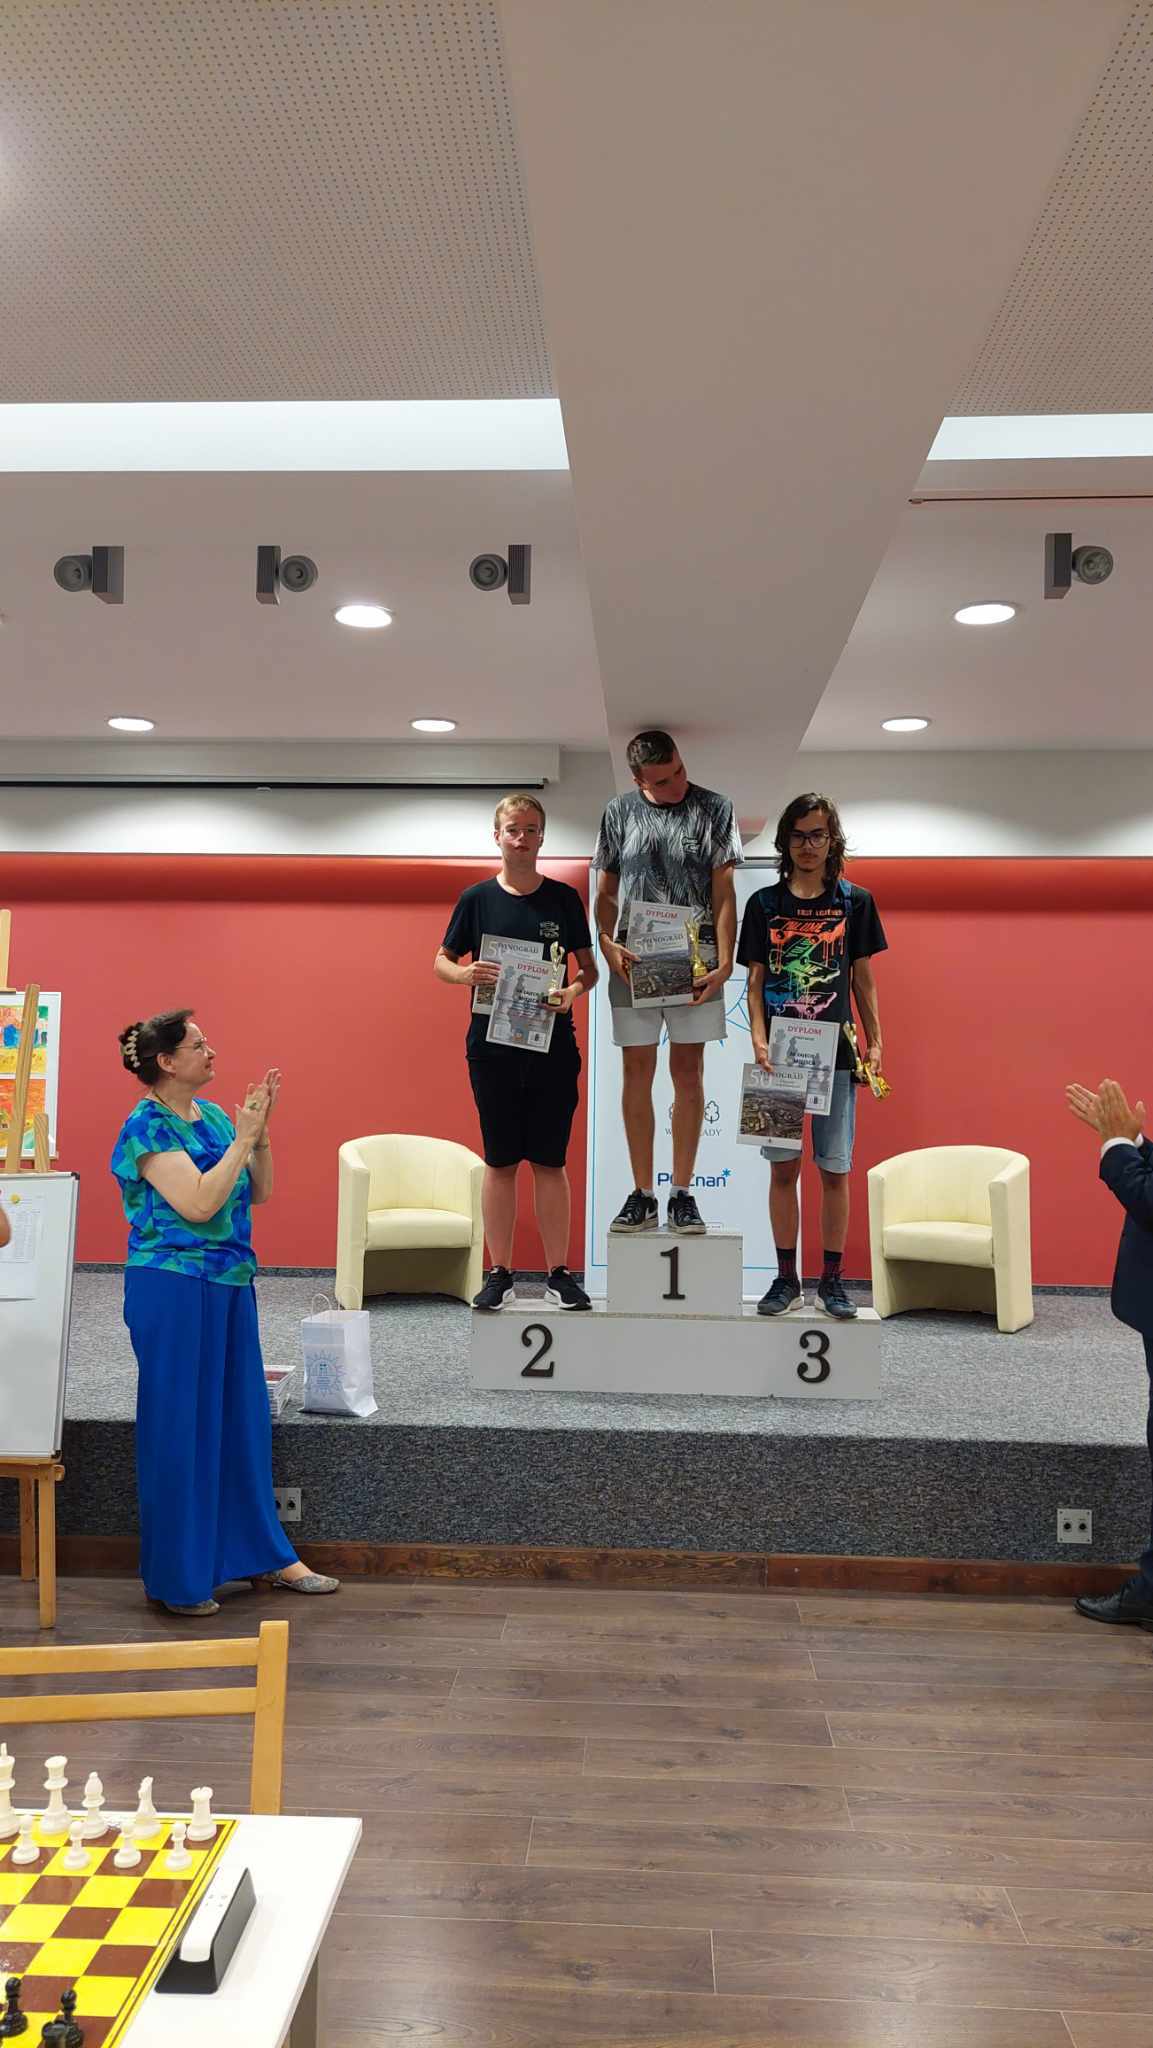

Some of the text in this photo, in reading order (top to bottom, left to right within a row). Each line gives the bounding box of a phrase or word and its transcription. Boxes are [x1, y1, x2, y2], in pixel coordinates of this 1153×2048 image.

[646, 910, 677, 919] DYPLOM
[517, 963, 548, 975] DYPLOM
[787, 1025, 822, 1036] DYPLOM
[660, 1246, 686, 1300] 1
[520, 1323, 556, 1377] 2
[796, 1330, 831, 1383] 3
